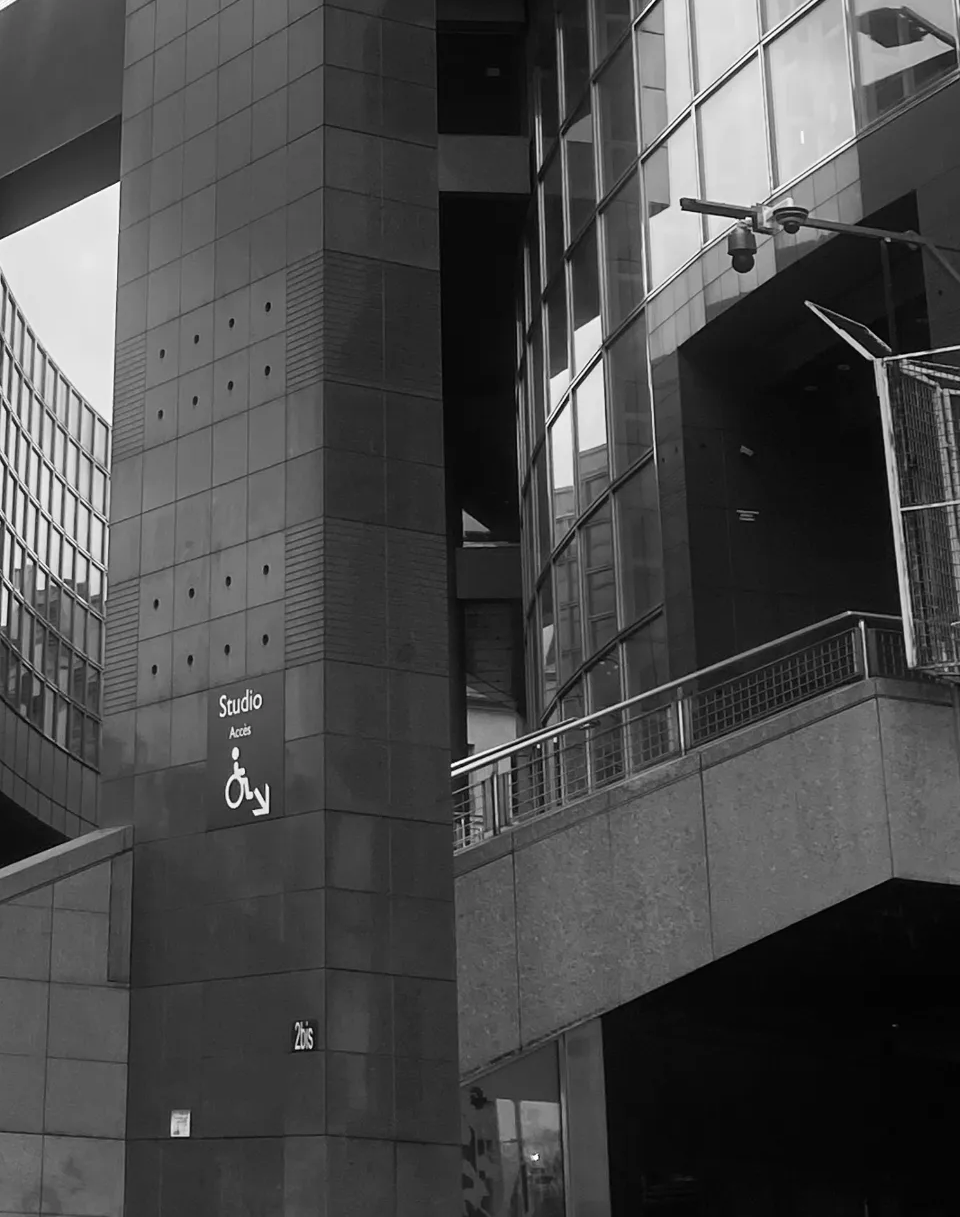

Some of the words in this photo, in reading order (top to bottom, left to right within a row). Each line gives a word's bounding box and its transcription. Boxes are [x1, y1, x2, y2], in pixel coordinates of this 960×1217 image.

[219, 689, 263, 718] Studio
[228, 723, 252, 740] Accès
[294, 1020, 314, 1050] 2bis
